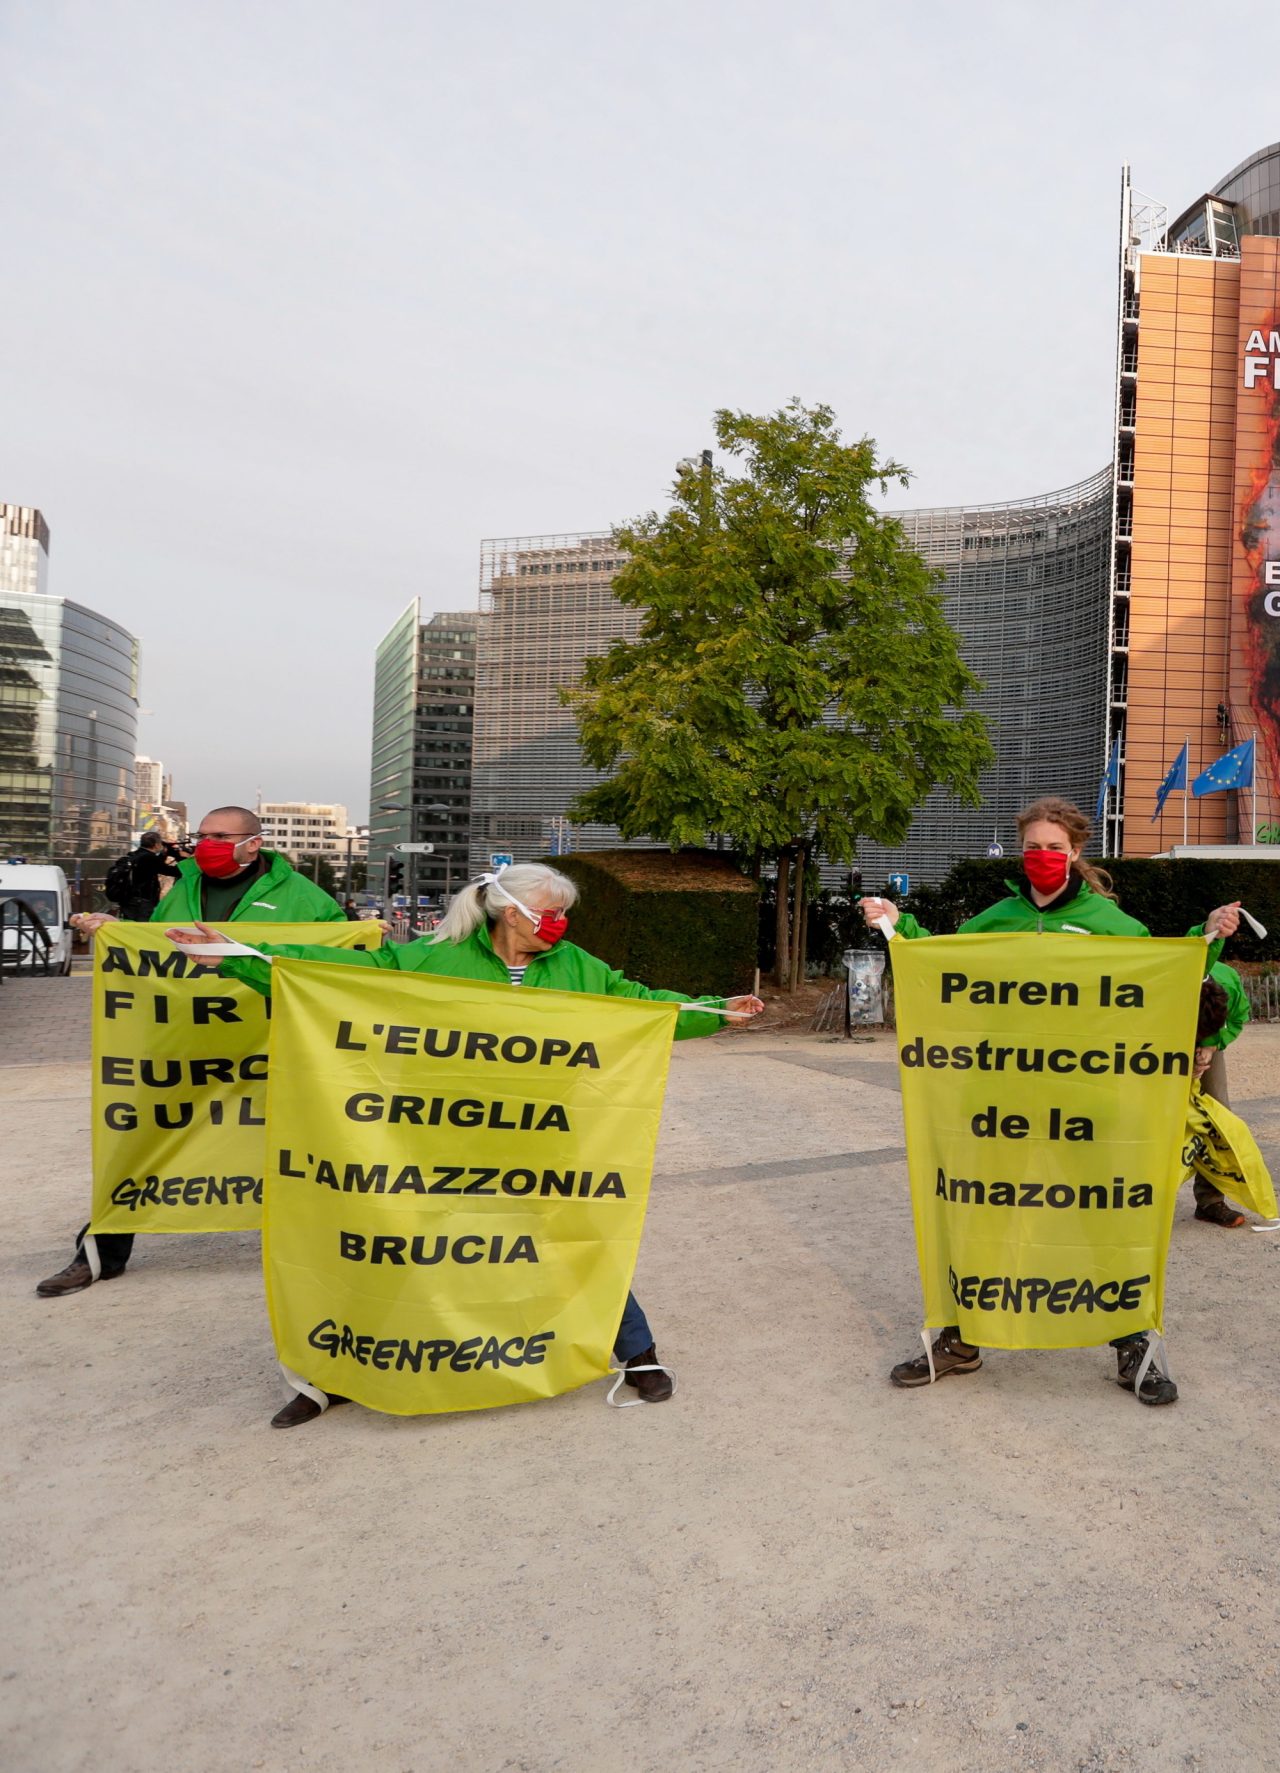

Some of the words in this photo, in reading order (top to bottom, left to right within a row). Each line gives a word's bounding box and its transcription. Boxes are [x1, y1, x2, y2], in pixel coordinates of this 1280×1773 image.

[106, 989, 271, 1024] FIR
[942, 973, 1078, 1006] Paren
[1100, 976, 1143, 1007] la
[336, 1021, 600, 1068] L'EUROPA
[901, 1037, 1189, 1075] destrucción
[103, 1055, 268, 1087] EURO
[105, 1097, 265, 1131] GUIL
[345, 1093, 569, 1131] GRIGLIA
[972, 1106, 1029, 1138] de
[1050, 1109, 1093, 1141] la
[279, 1150, 625, 1198] L'AMAZZONIA
[936, 1168, 1152, 1209] Amazonia
[341, 1231, 538, 1265] BRUCIA
[949, 1265, 1150, 1314] REENPEACE
[308, 1319, 555, 1373] GREENPEACE
